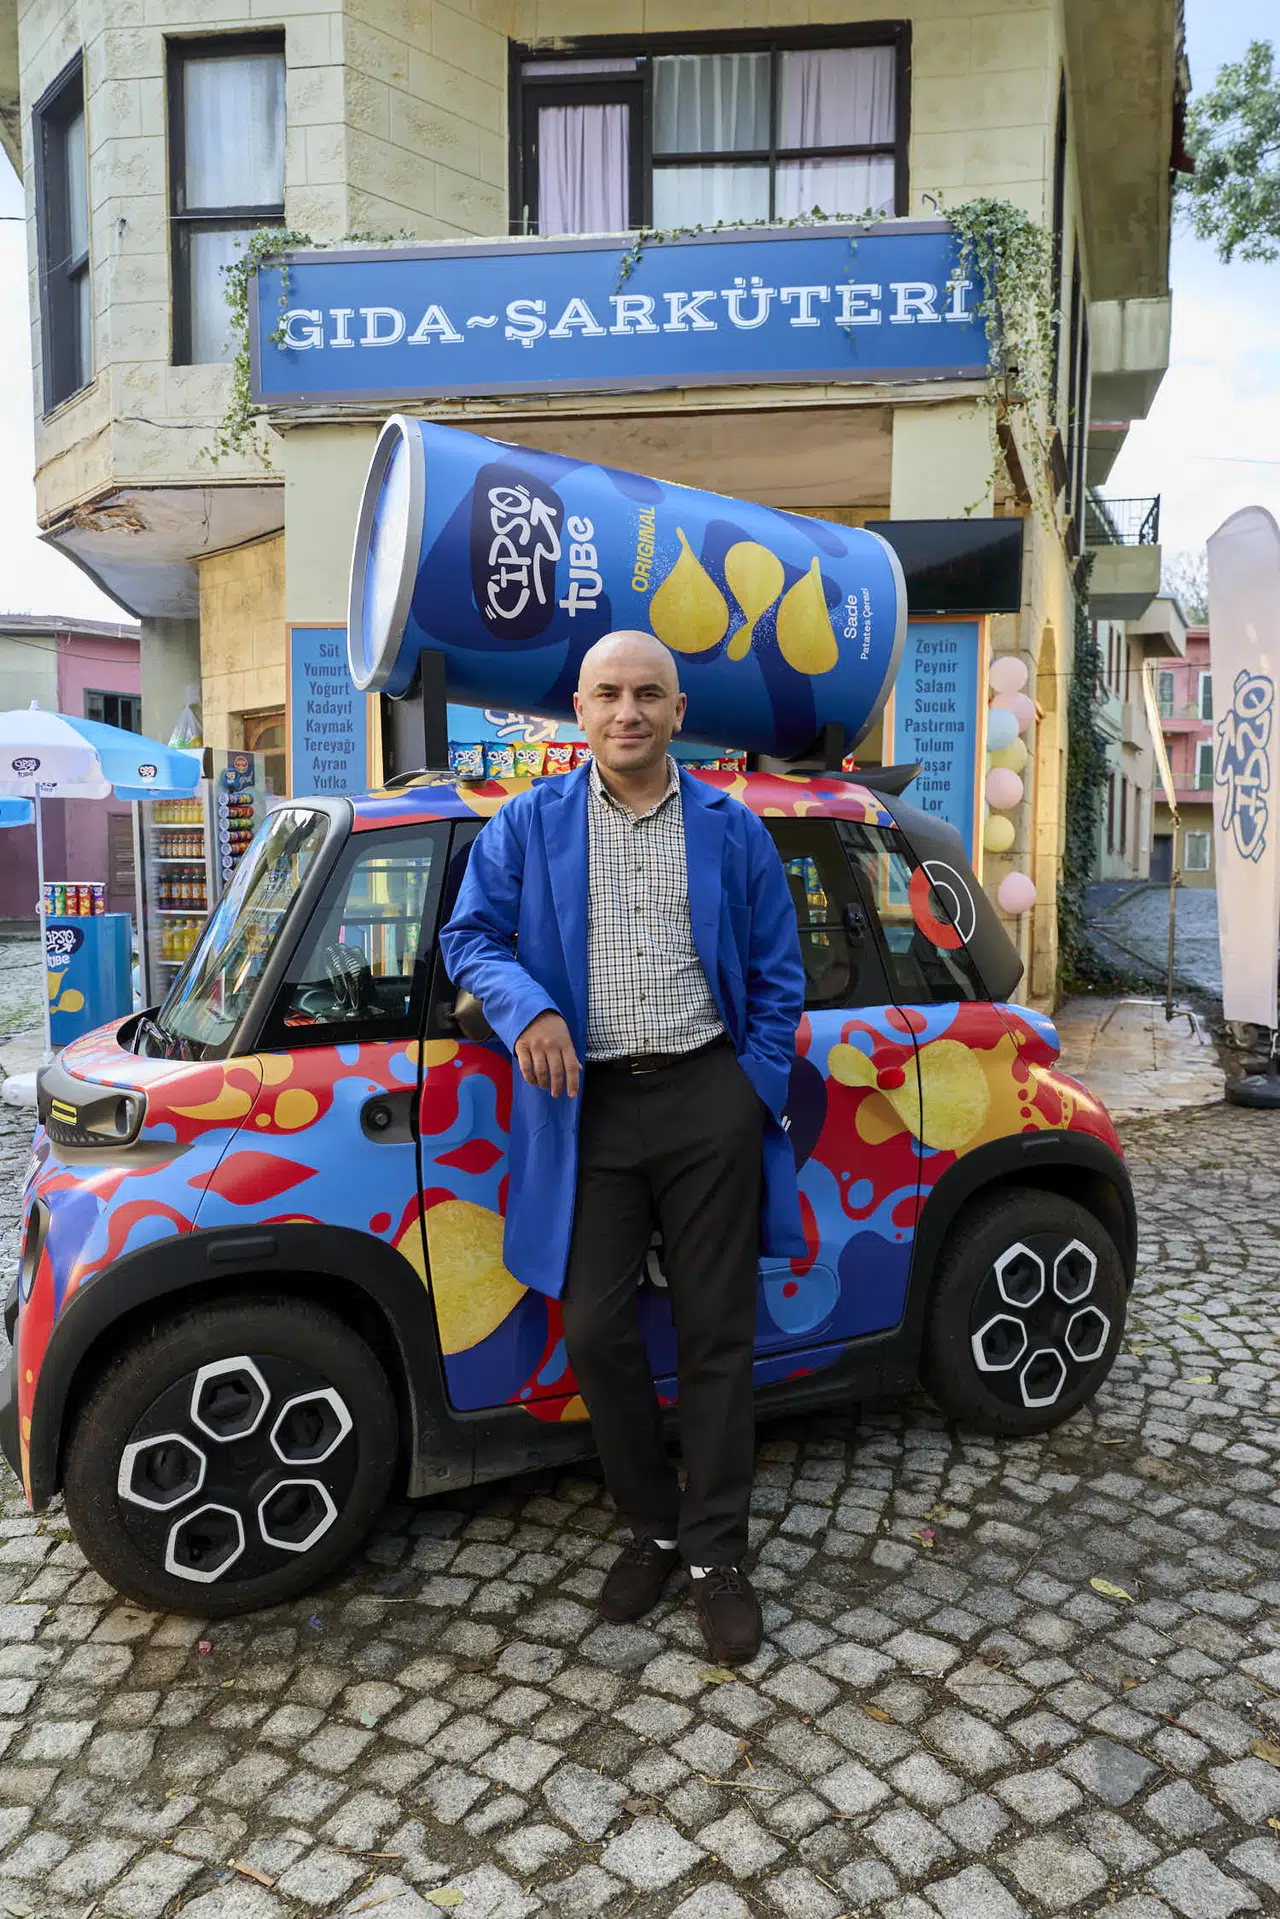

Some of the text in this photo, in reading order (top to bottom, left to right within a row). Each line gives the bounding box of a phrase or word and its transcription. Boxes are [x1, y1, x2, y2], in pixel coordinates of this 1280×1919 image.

[631, 506, 656, 592] ORIGINAL
[843, 594, 858, 639] Sade
[860, 620, 871, 660] Patates
[915, 639, 957, 656] Zeytin
[319, 643, 340, 658] Süt
[304, 663, 350, 677] Yumurt
[914, 659, 959, 675] Peynir
[309, 681, 350, 698] Yoğurt
[915, 679, 956, 693] Salam
[307, 700, 352, 715] Kadayıf
[915, 698, 956, 713] Sucuk
[306, 719, 354, 735] Kaymak
[905, 717, 965, 733] Pastırma
[304, 737, 355, 754] Tereyağı
[914, 737, 954, 753] Tulum
[312, 756, 347, 772] Ayran
[313, 775, 347, 789] Yufka
[915, 776, 951, 791] Füme
[922, 797, 944, 811] Lor
